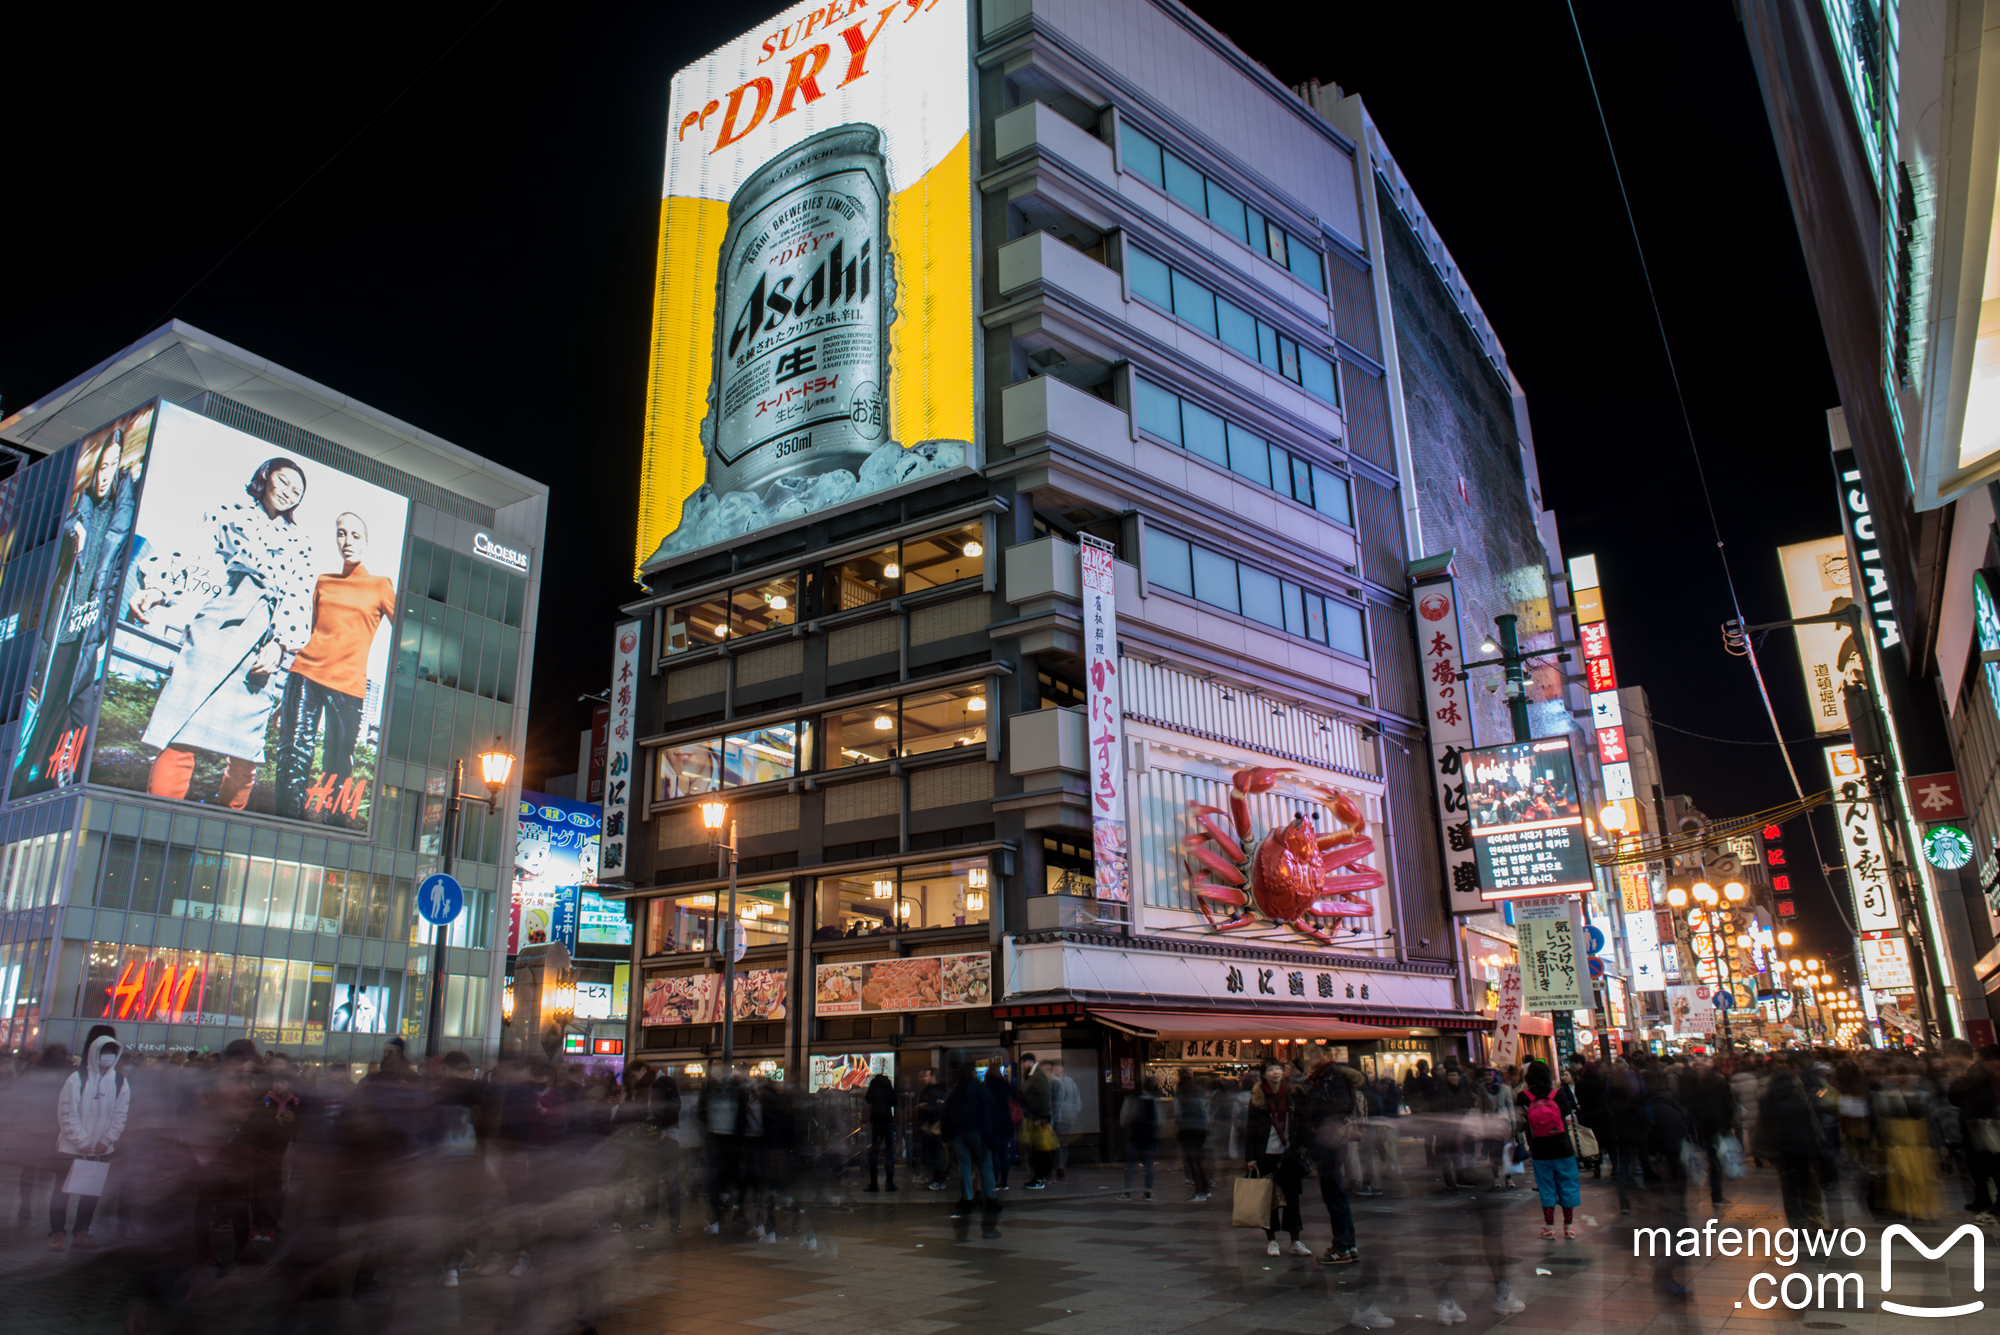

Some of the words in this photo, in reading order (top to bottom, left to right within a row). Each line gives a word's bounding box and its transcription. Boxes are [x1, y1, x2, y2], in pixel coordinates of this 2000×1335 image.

[748, 232, 770, 264] ASAHI
[772, 196, 823, 231] BREWERIES
[826, 197, 856, 221] LIMITED
[786, 231, 813, 248] SUPER
[728, 237, 872, 361] Asahi
[775, 344, 818, 385] 生
[755, 374, 839, 419] スーパードライ
[852, 398, 882, 426] お酒
[776, 432, 813, 458] 350ml
[69, 608, 100, 633] ¥7,499
[72, 597, 100, 618] ジャケット
[1427, 630, 1463, 727] 本場の味
[1813, 663, 1838, 717] 道頓堀店
[614, 659, 634, 742] 本場の味
[1088, 656, 1117, 812] かにすき
[304, 771, 367, 820] H&M
[1918, 782, 1954, 812] 本
[1536, 950, 1551, 992] 客引き
[1546, 929, 1560, 972] しつこい
